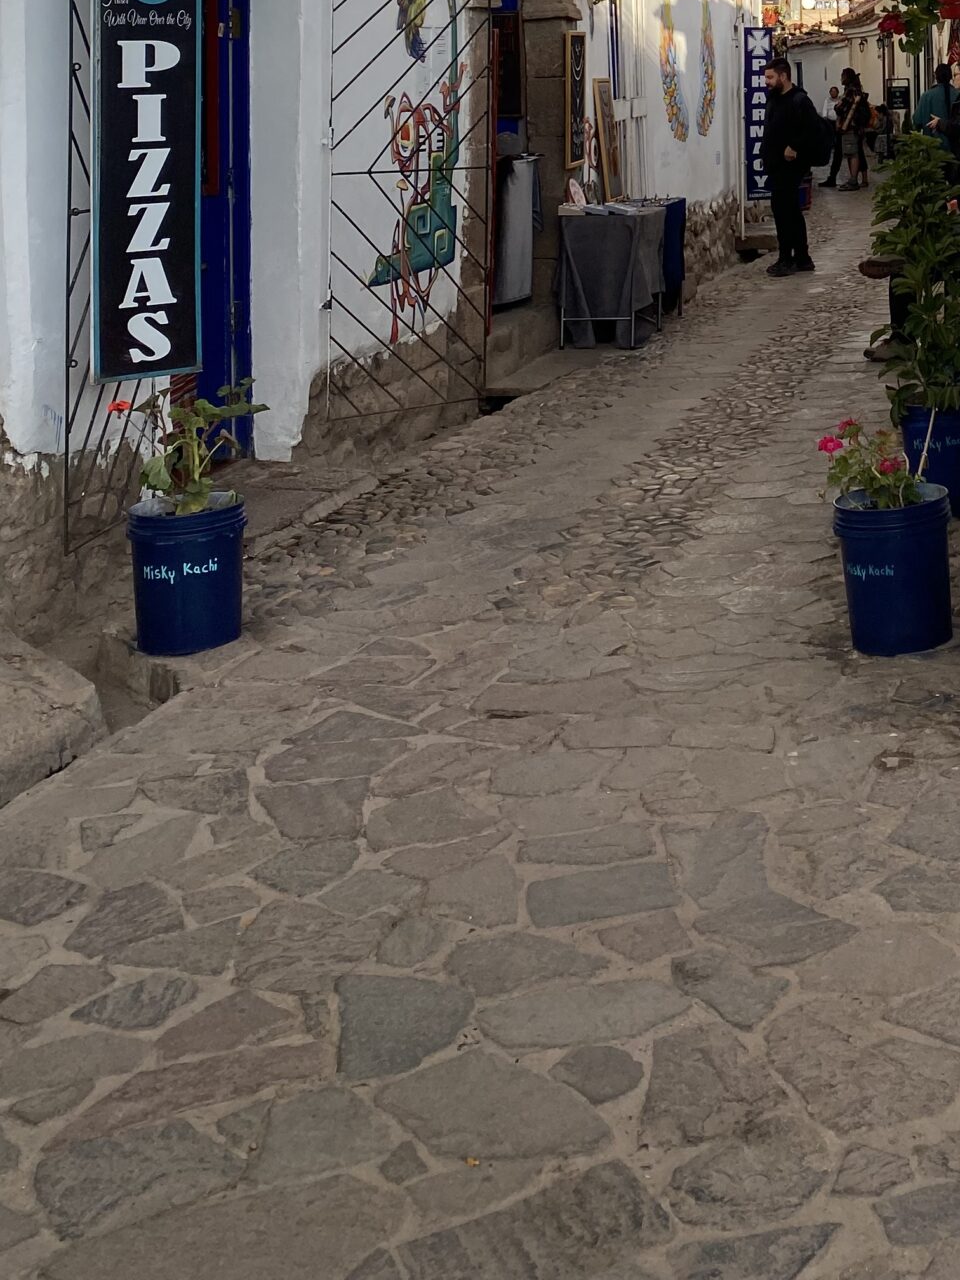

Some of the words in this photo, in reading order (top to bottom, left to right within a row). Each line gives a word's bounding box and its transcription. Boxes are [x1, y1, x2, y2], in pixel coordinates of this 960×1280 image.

[103, 9, 126, 27] With
[127, 8, 148, 27] View
[148, 9, 165, 26] Over
[166, 13, 175, 25] the
[176, 9, 192, 30] City
[117, 39, 181, 364] PIZZAS
[183, 557, 218, 576] Kachi
[868, 563, 895, 577] Kachi
